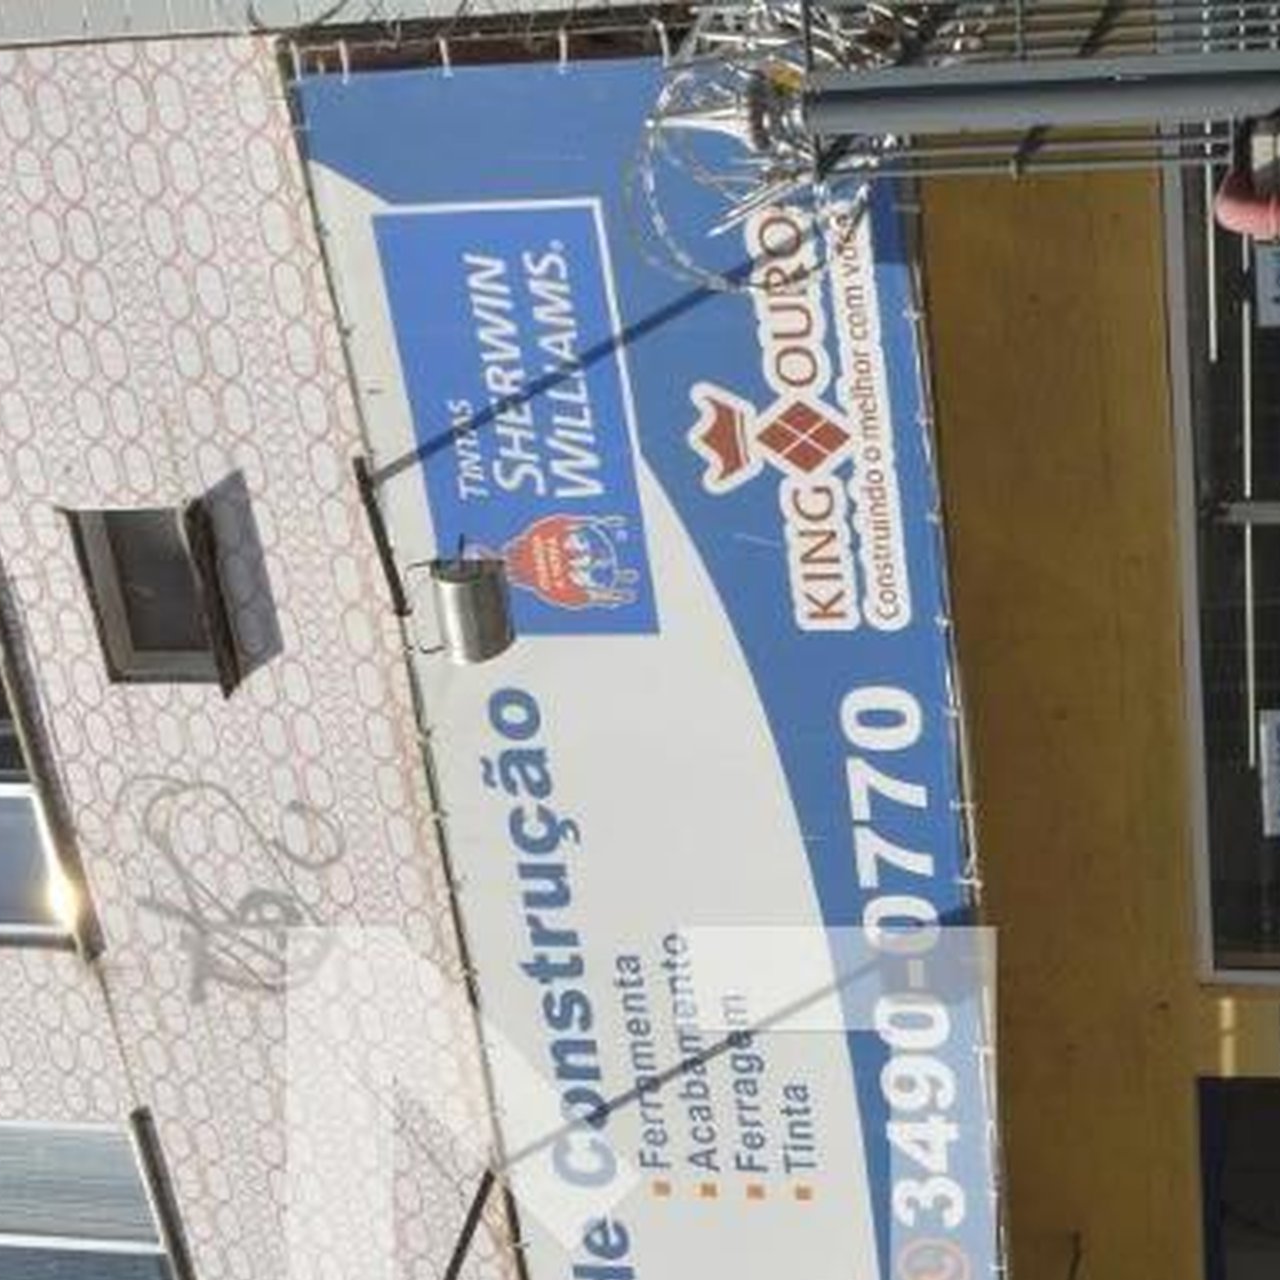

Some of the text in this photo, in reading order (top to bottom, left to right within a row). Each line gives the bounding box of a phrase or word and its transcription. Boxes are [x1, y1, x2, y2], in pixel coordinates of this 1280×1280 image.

[463, 252, 547, 496] SHERWIN
[842, 284, 870, 342] com
[844, 350, 881, 440] melhor
[447, 399, 490, 500] TINTAS
[757, 215, 847, 622] KING OURO
[861, 447, 881, 461] o
[861, 469, 900, 621] Construindo
[480, 686, 619, 1188] Construção
[840, 685, 966, 1229] 3490-0770
[613, 954, 671, 1170] Ferramenta
[659, 932, 720, 1173] Acabamento
[721, 994, 769, 1174] Ferragem
[779, 1083, 817, 1175] Tinta
